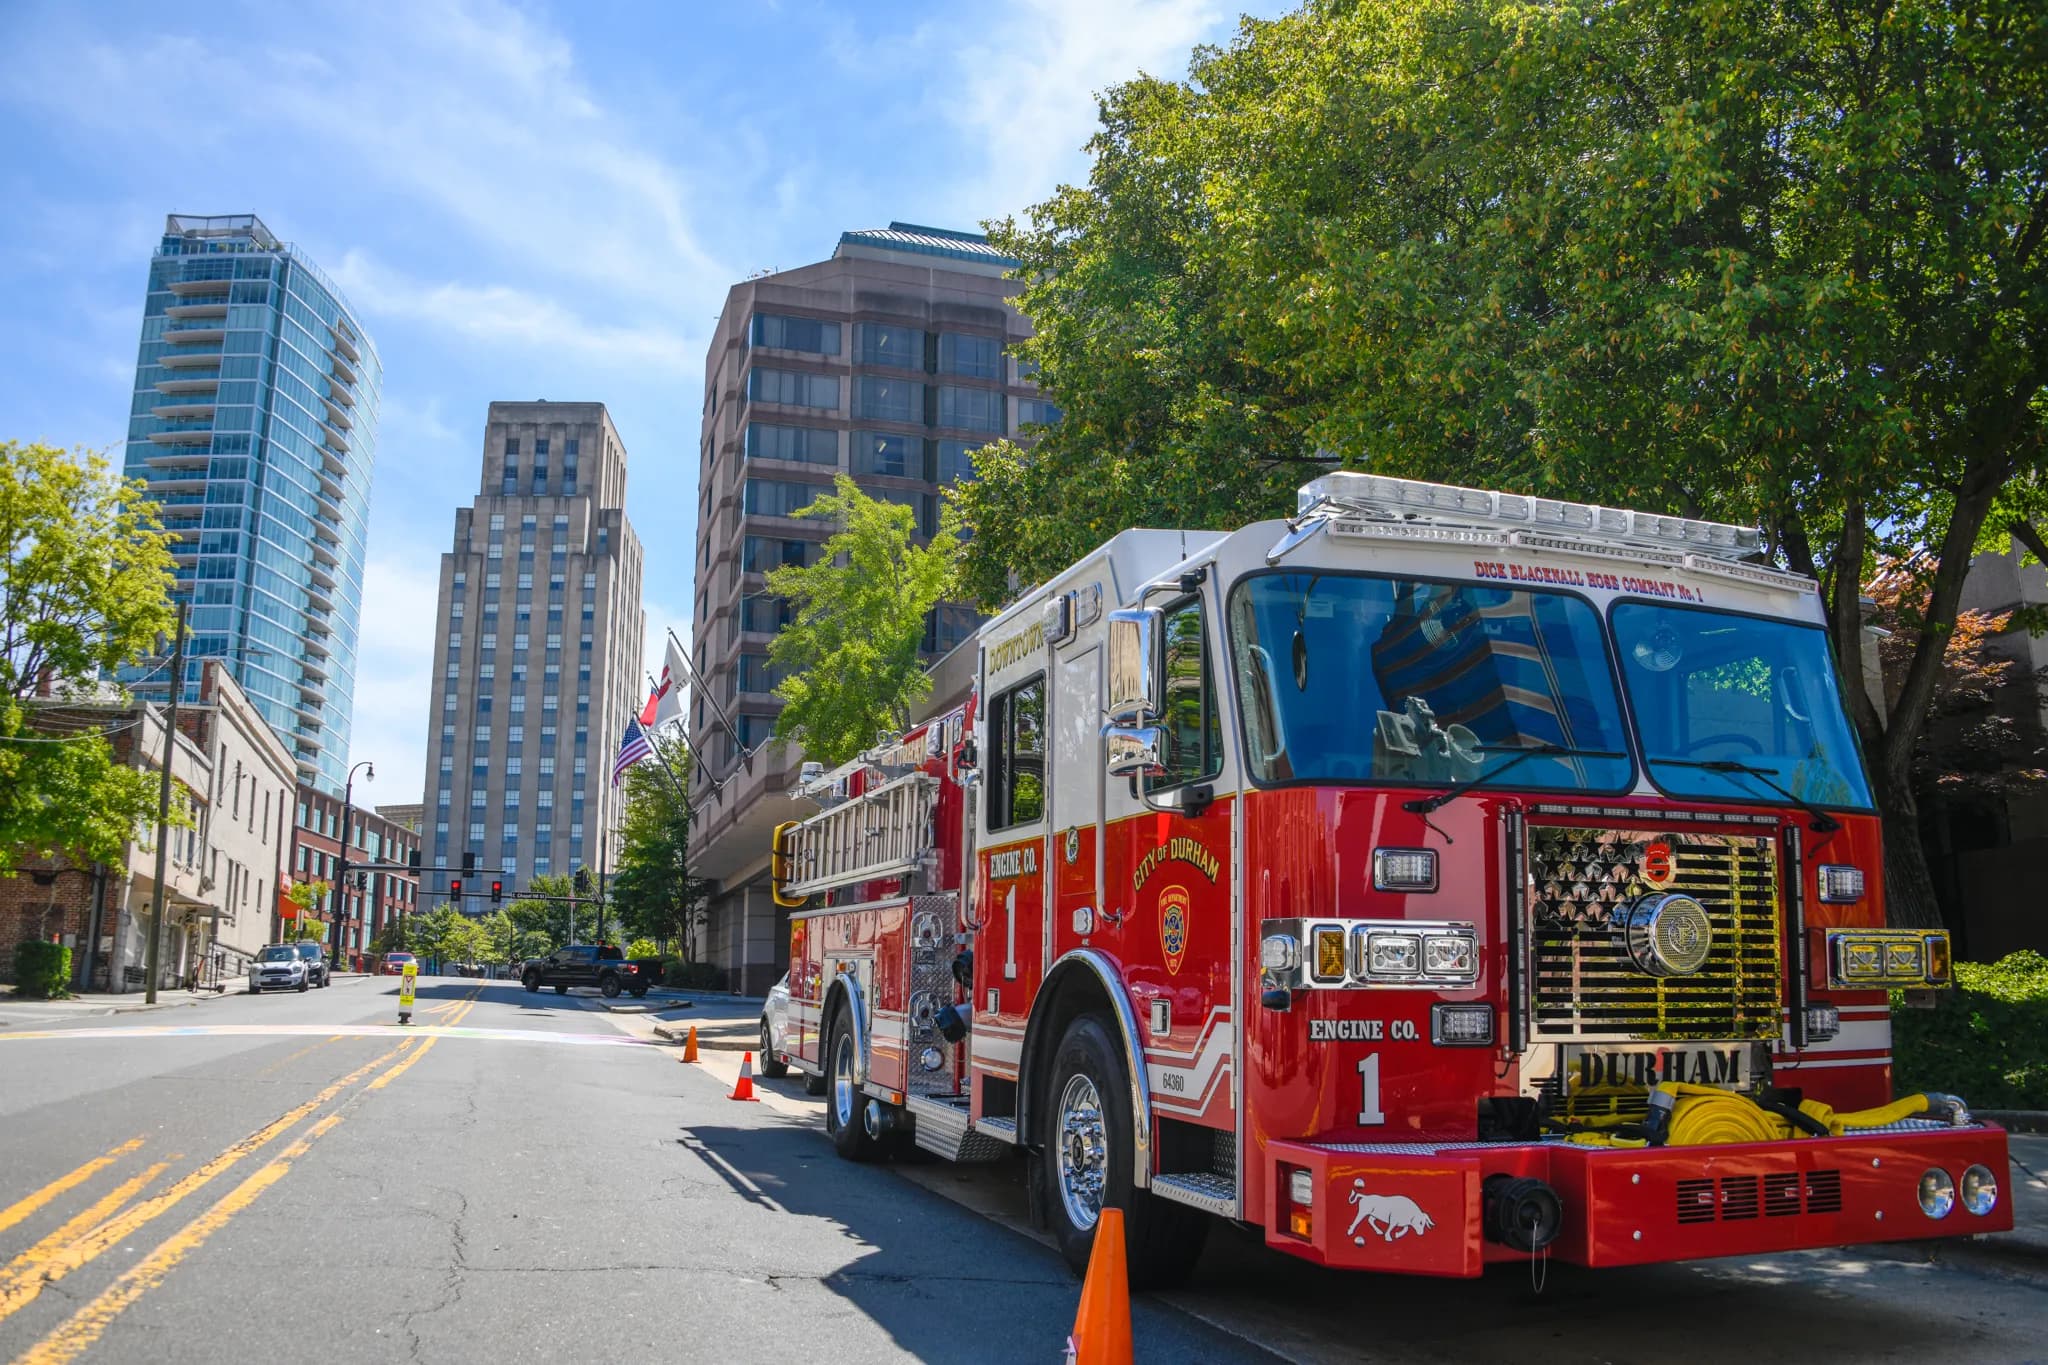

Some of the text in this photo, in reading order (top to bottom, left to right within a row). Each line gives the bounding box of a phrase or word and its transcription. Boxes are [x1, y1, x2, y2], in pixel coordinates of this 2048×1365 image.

[1474, 561, 1507, 579] DICK
[1509, 564, 1584, 586] BLACKNALL
[1586, 572, 1619, 590] HOSE
[1622, 577, 1675, 598] COMPANY
[1696, 587, 1704, 603] 1
[989, 620, 1043, 676] DOWNTOWN
[990, 847, 1037, 879] ENGINE CO.
[1133, 837, 1220, 891] CITY OF DURHAM
[1004, 883, 1017, 980] 1
[1309, 1019, 1420, 1040] ENGINE CO.
[1162, 1072, 1184, 1092] 64360
[1357, 1052, 1385, 1125] 1
[1579, 1049, 1741, 1087] DURHAM
